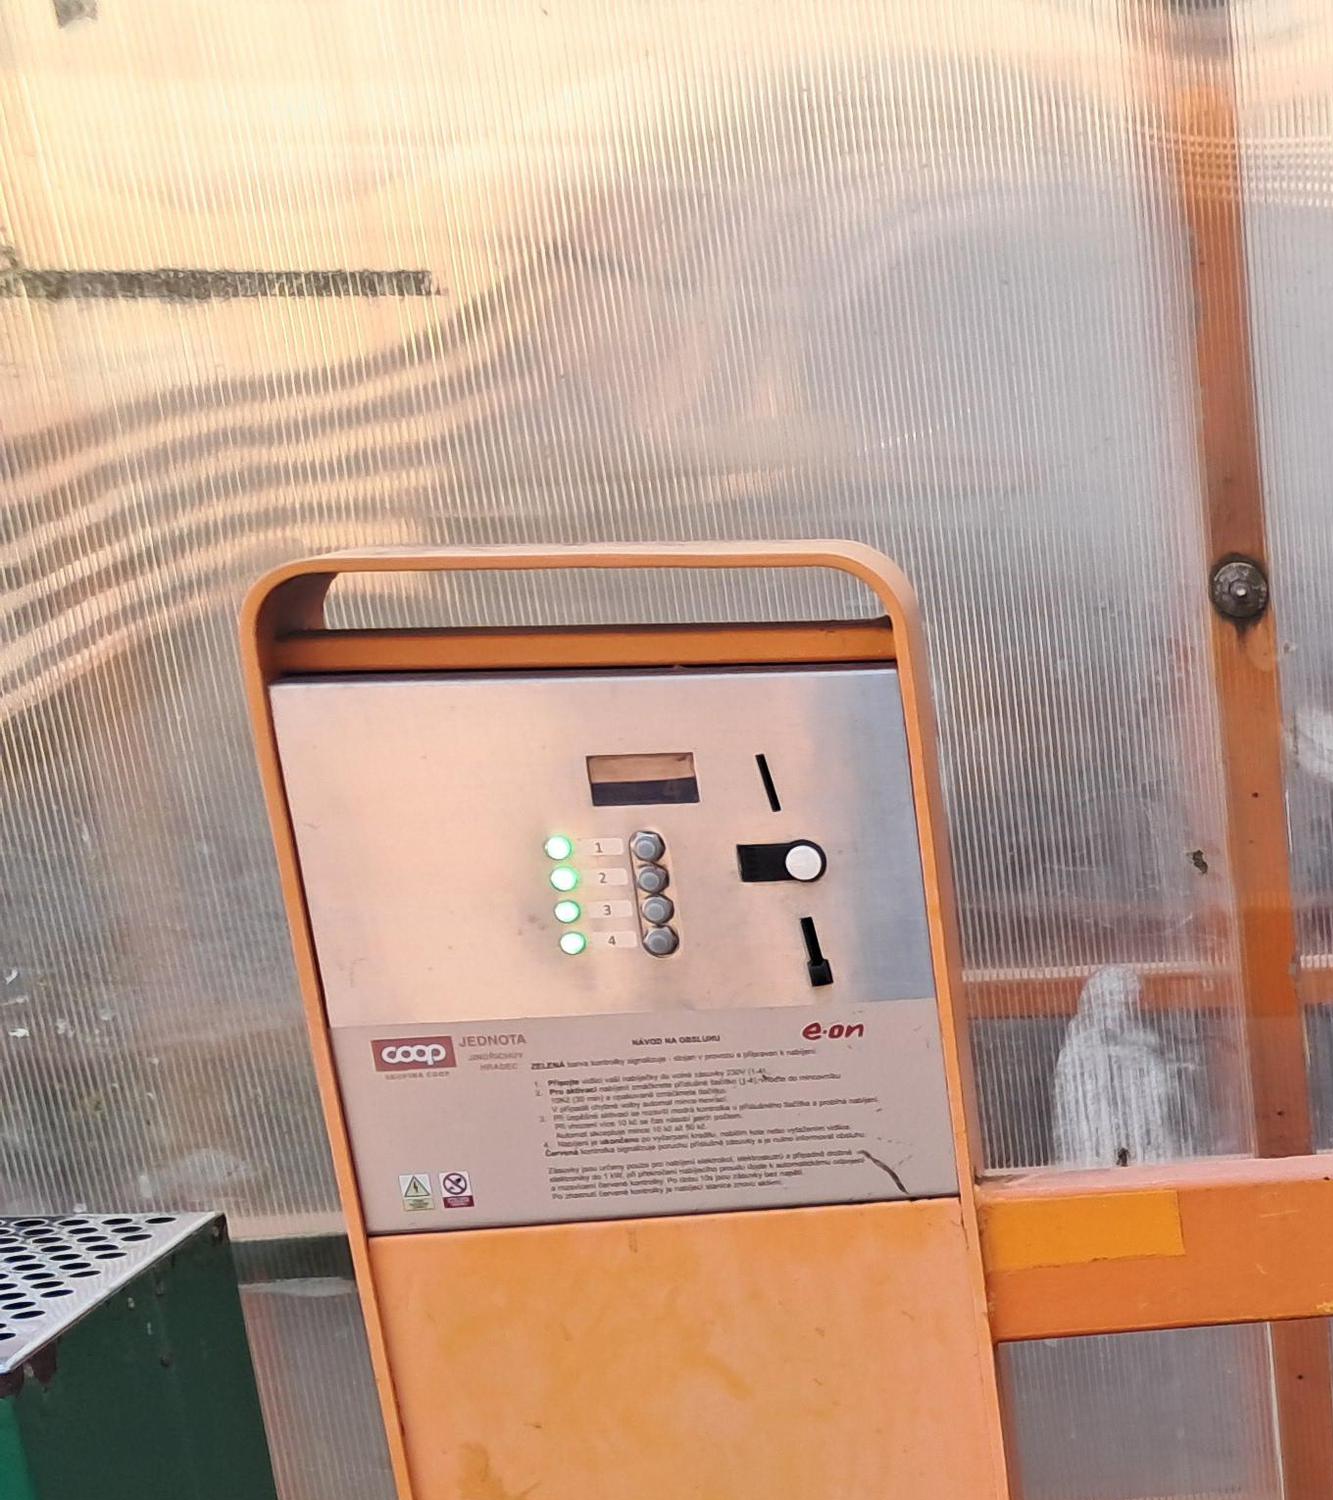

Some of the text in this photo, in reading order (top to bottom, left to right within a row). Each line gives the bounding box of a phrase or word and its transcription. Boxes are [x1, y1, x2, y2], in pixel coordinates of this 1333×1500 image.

[595, 843, 603, 853] 1
[599, 872, 607, 883] 2
[603, 904, 611, 916] 3
[608, 935, 616, 946] 4
[459, 1034, 526, 1048] JEDNOTA
[381, 1043, 446, 1066] coop
